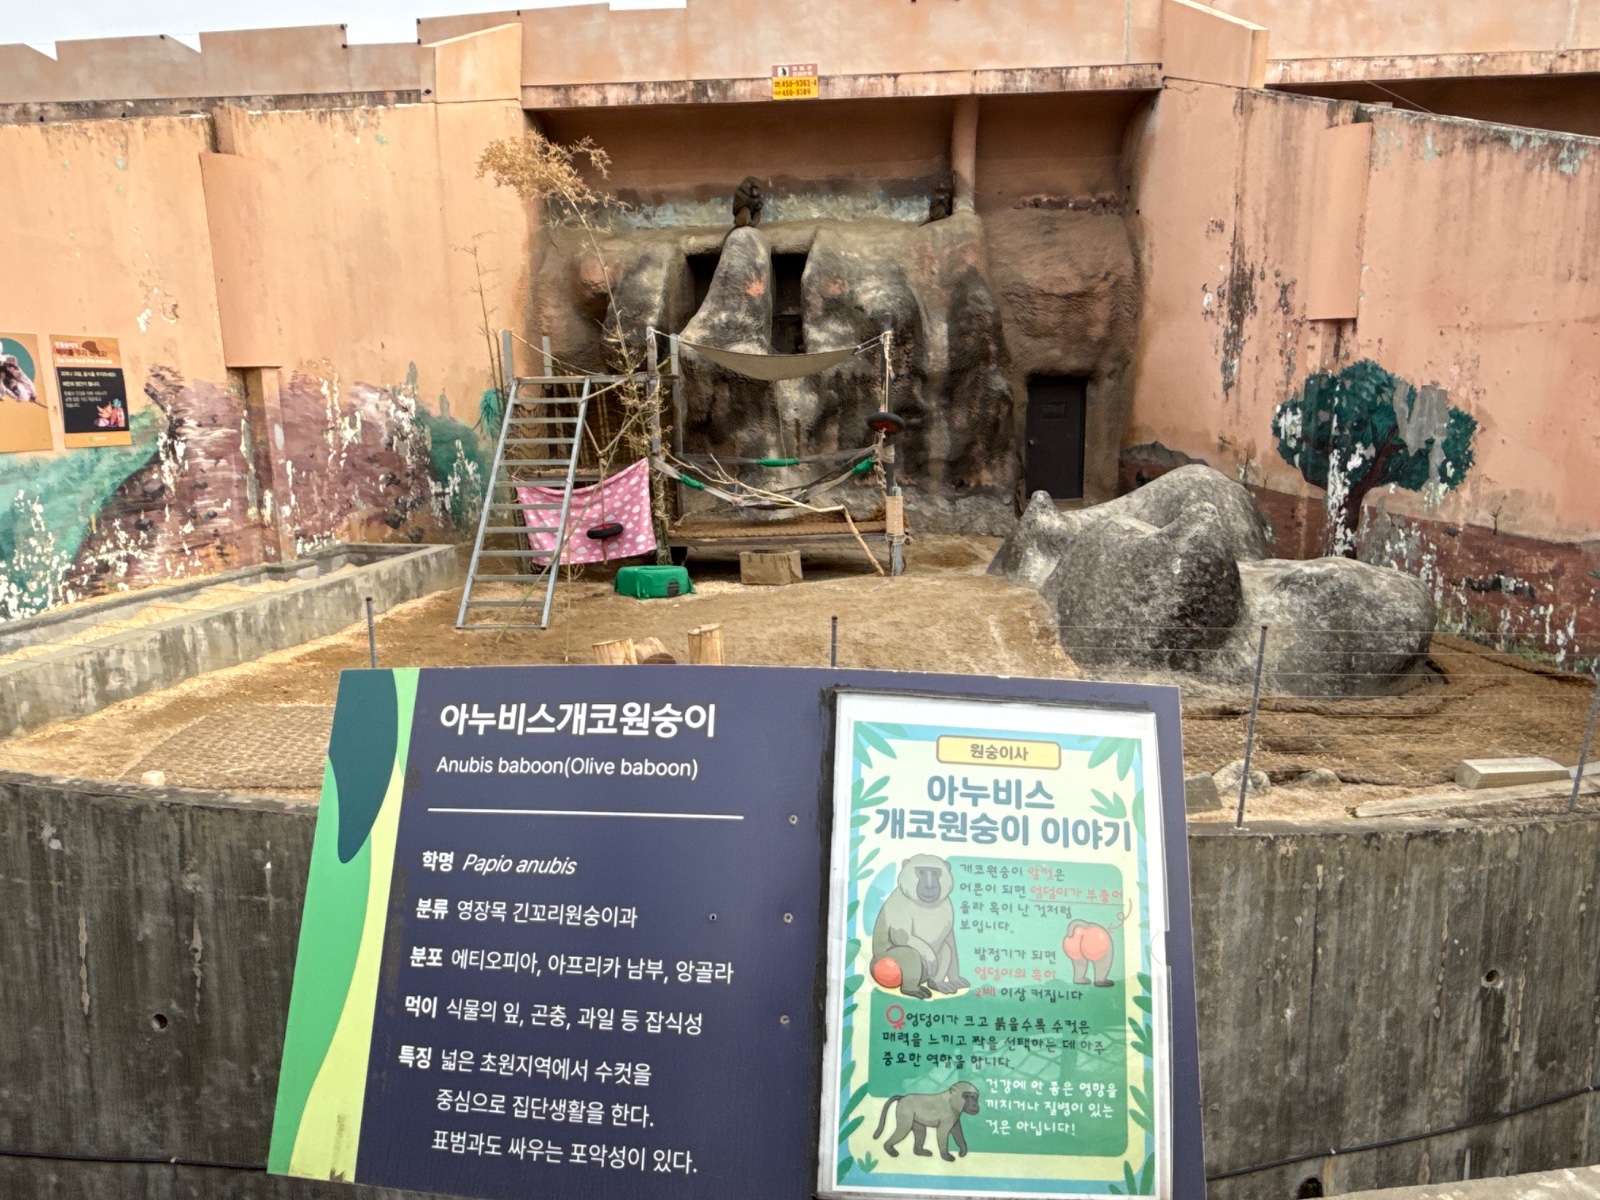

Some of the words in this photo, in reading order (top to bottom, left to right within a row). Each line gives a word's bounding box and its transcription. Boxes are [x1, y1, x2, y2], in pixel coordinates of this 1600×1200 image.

[440, 702, 716, 738] 아누비스개코원숭이
[969, 743, 1029, 762] 원숭이사
[436, 756, 494, 774] Anubis
[498, 757, 615, 778] baboon(Olive
[620, 758, 698, 780] baboon)
[927, 775, 1055, 810] 아누비스
[874, 807, 1029, 846] 개코원숭이
[1041, 817, 1132, 852] 이야기
[422, 850, 454, 872] 학명
[462, 853, 513, 876] Papio
[516, 855, 577, 875] anubis
[959, 864, 1023, 879] 개코원숭이
[1027, 866, 1066, 882] 암컷은
[959, 882, 997, 897] 어른이
[1001, 885, 1026, 898] 되면
[1030, 886, 1082, 899] 엉덩이가
[415, 898, 449, 920] 분류
[457, 900, 507, 922] 영장목
[512, 903, 638, 928] 긴꼬리원숭이과
[960, 900, 984, 914] 올라
[988, 901, 1013, 916] 혹이
[1017, 905, 1030, 917] 난
[959, 919, 1015, 934] 보입니다.
[410, 946, 444, 968] 분포
[451, 949, 542, 977] 에티오피아,
[548, 953, 622, 979] 아프리카
[627, 959, 669, 984] 남부,
[676, 961, 735, 985] 앙골라
[974, 947, 1026, 961] 발정기가
[1031, 950, 1056, 964] 되면
[974, 966, 1025, 981] 엉덩이의
[1031, 968, 1056, 982] 혹이
[974, 988, 996, 997] 2배
[1000, 988, 1026, 1002] 이상
[1030, 989, 1083, 1003] 커집니다
[405, 996, 438, 1018] 먹이
[446, 998, 497, 1023] 식물의
[503, 1002, 524, 1028] 잎,
[531, 1004, 571, 1030] 곤충,
[577, 1006, 614, 1031] 과일
[620, 1010, 639, 1032] 등
[645, 1011, 703, 1036] 잡식성
[906, 1013, 959, 1027] 엉덩이가
[964, 1015, 989, 1027] 크고
[995, 1016, 1046, 1033] 붉을수록
[1052, 1019, 1090, 1035] 수컷은
[882, 1032, 922, 1048] 매력을
[928, 1034, 967, 1046] 느끼고
[972, 1035, 998, 1052] 짝을
[1004, 1036, 1057, 1053] 선택하는
[1062, 1040, 1075, 1050] 데
[1080, 1041, 1106, 1055] 아주
[398, 1045, 432, 1069] 특징
[441, 1049, 475, 1072] 넓은
[479, 1053, 589, 1081] 초원지역에서
[594, 1062, 652, 1086] 수컷을
[882, 1052, 922, 1068] 중요한
[926, 1053, 965, 1070] 역할을
[970, 1055, 1015, 1071] 합니다.
[985, 1078, 1026, 1094] 건강에
[1030, 1080, 1044, 1095] 안
[1049, 1081, 1074, 1097] 좋은
[1079, 1082, 1118, 1099] 영향을
[436, 1088, 506, 1115] 중심으로
[511, 1095, 605, 1124] 집단생활을
[611, 1103, 654, 1128] 한다.
[985, 1099, 1039, 1112] 끼치거나
[1043, 1101, 1083, 1117] 질병이
[1088, 1103, 1114, 1118] 있는
[985, 1119, 1011, 1136] 것은
[1016, 1121, 1075, 1136] 아닙니다!
[431, 1130, 502, 1156] 표범과도
[508, 1137, 564, 1163] 싸우는
[568, 1143, 645, 1171] 포악성이
[652, 1149, 698, 1174] 있다.
